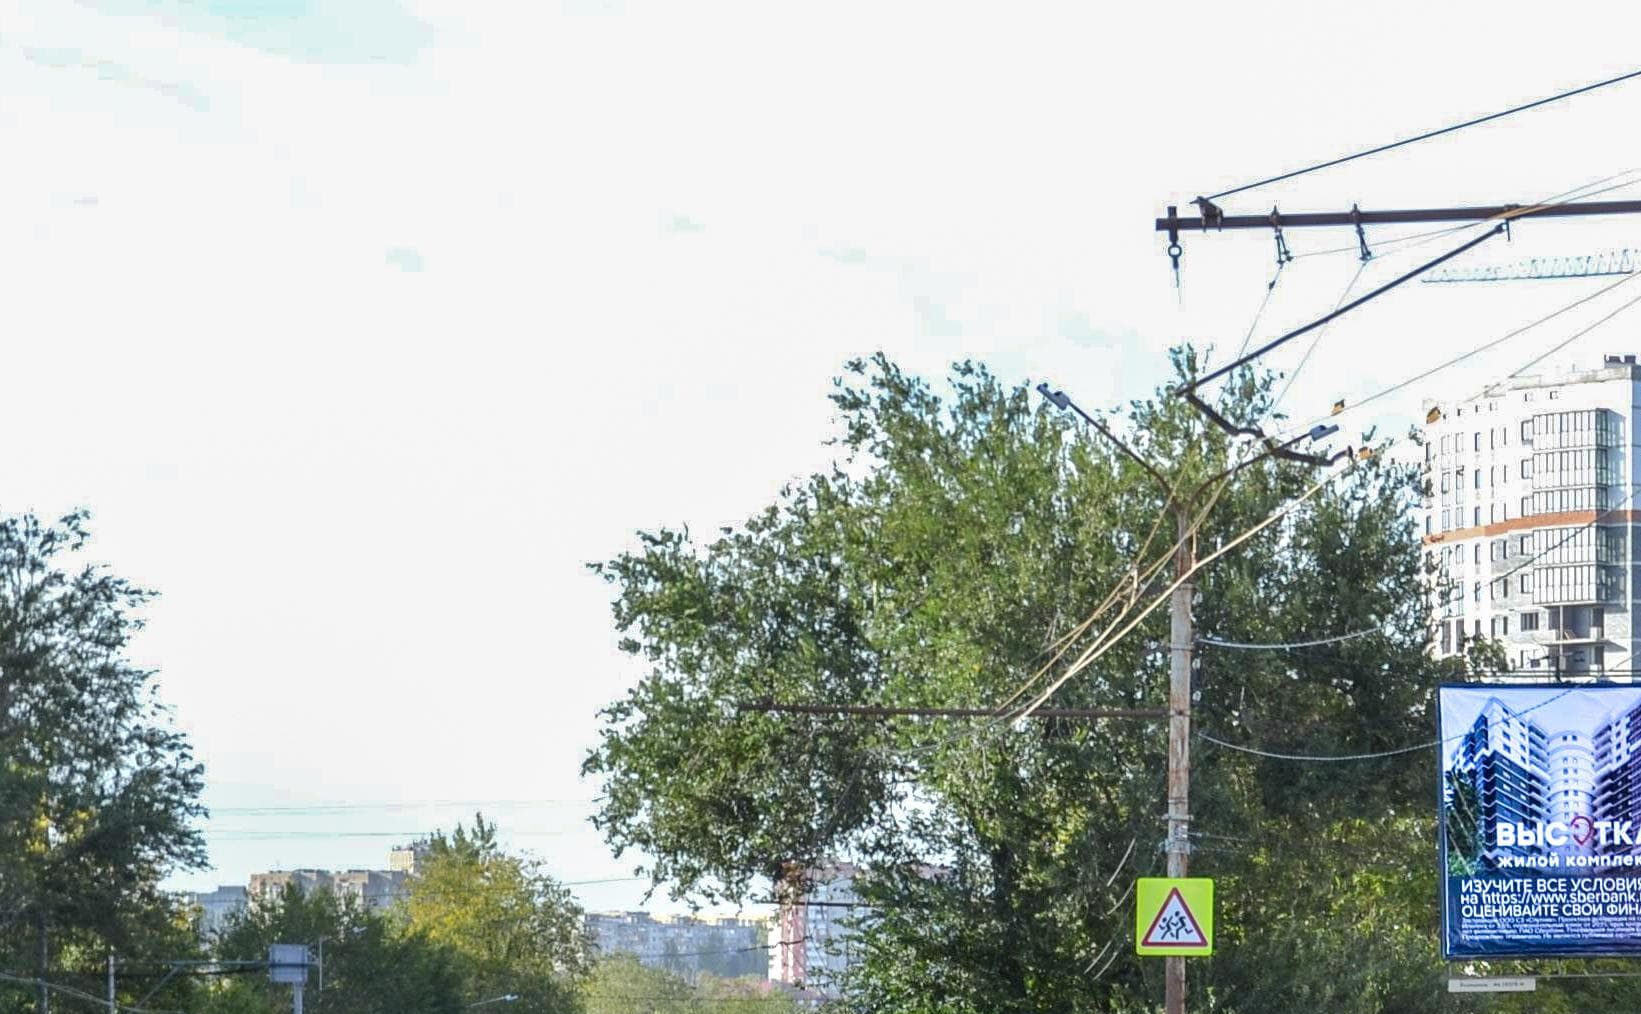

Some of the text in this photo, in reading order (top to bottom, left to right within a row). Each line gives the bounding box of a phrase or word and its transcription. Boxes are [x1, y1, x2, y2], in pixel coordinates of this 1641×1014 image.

[1496, 852, 1560, 869] жилой
[1460, 879, 1533, 894] ИЗУЧИТЕ
[1536, 878, 1568, 893] ВСЕ
[1461, 893, 1479, 905] на
[1460, 903, 1560, 918] ОЦЕНИВАЙТЕ
